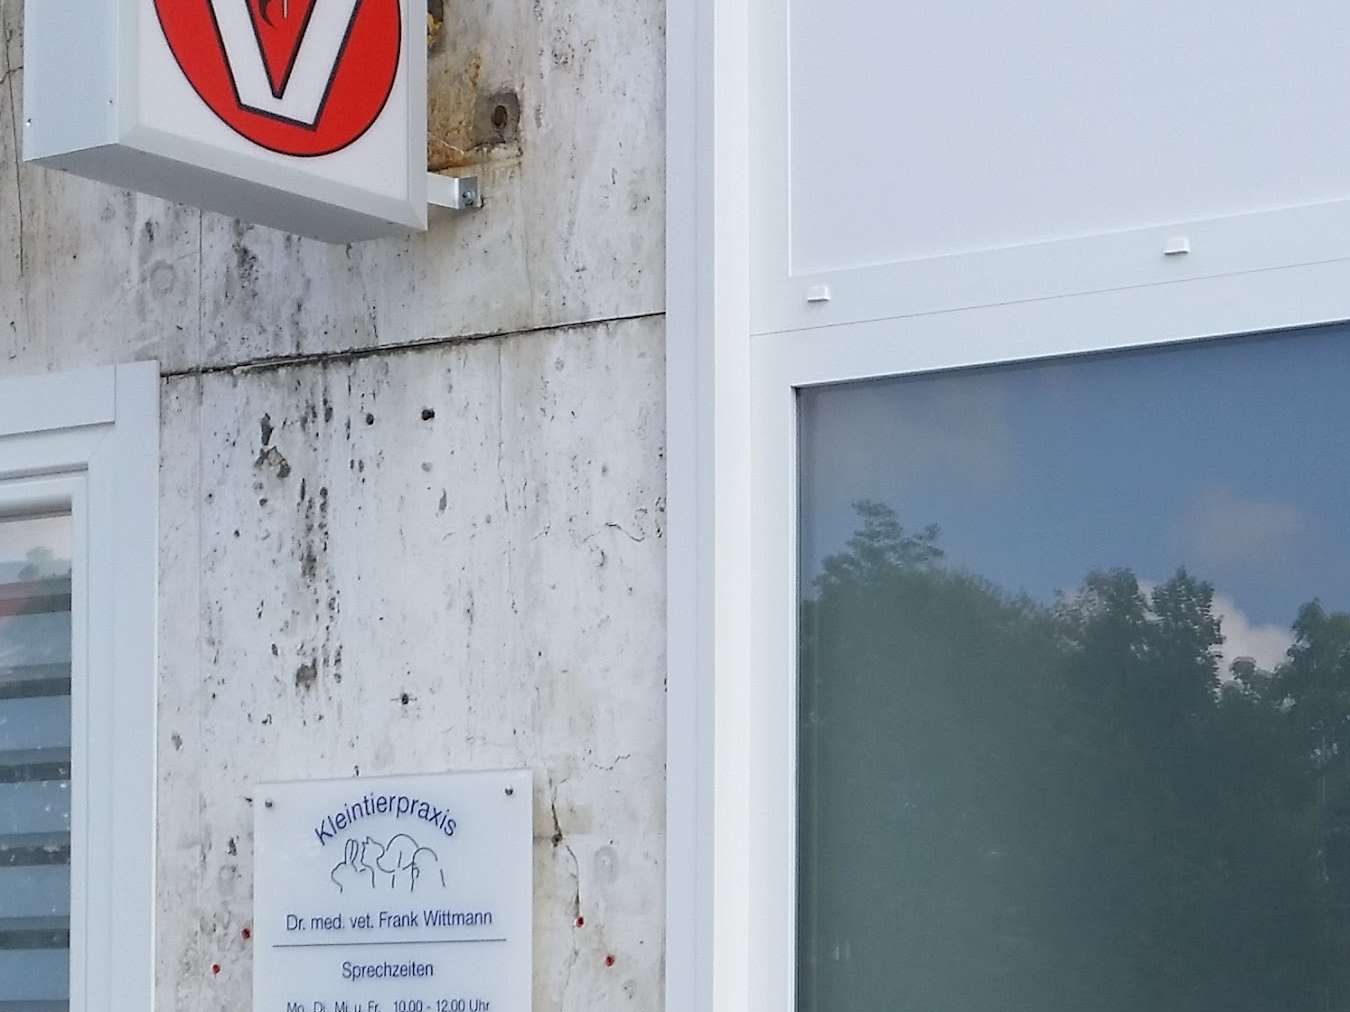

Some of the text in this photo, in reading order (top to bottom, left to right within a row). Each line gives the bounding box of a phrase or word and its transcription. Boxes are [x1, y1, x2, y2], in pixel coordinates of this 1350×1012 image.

[314, 792, 457, 846] Kleintierpraxis
[286, 909, 493, 932] Dr. med. vet. Frank Wittmann
[341, 960, 434, 982] Sprechzeiten
[436, 999, 466, 1012] 12.00
[469, 999, 490, 1012] Uhr
